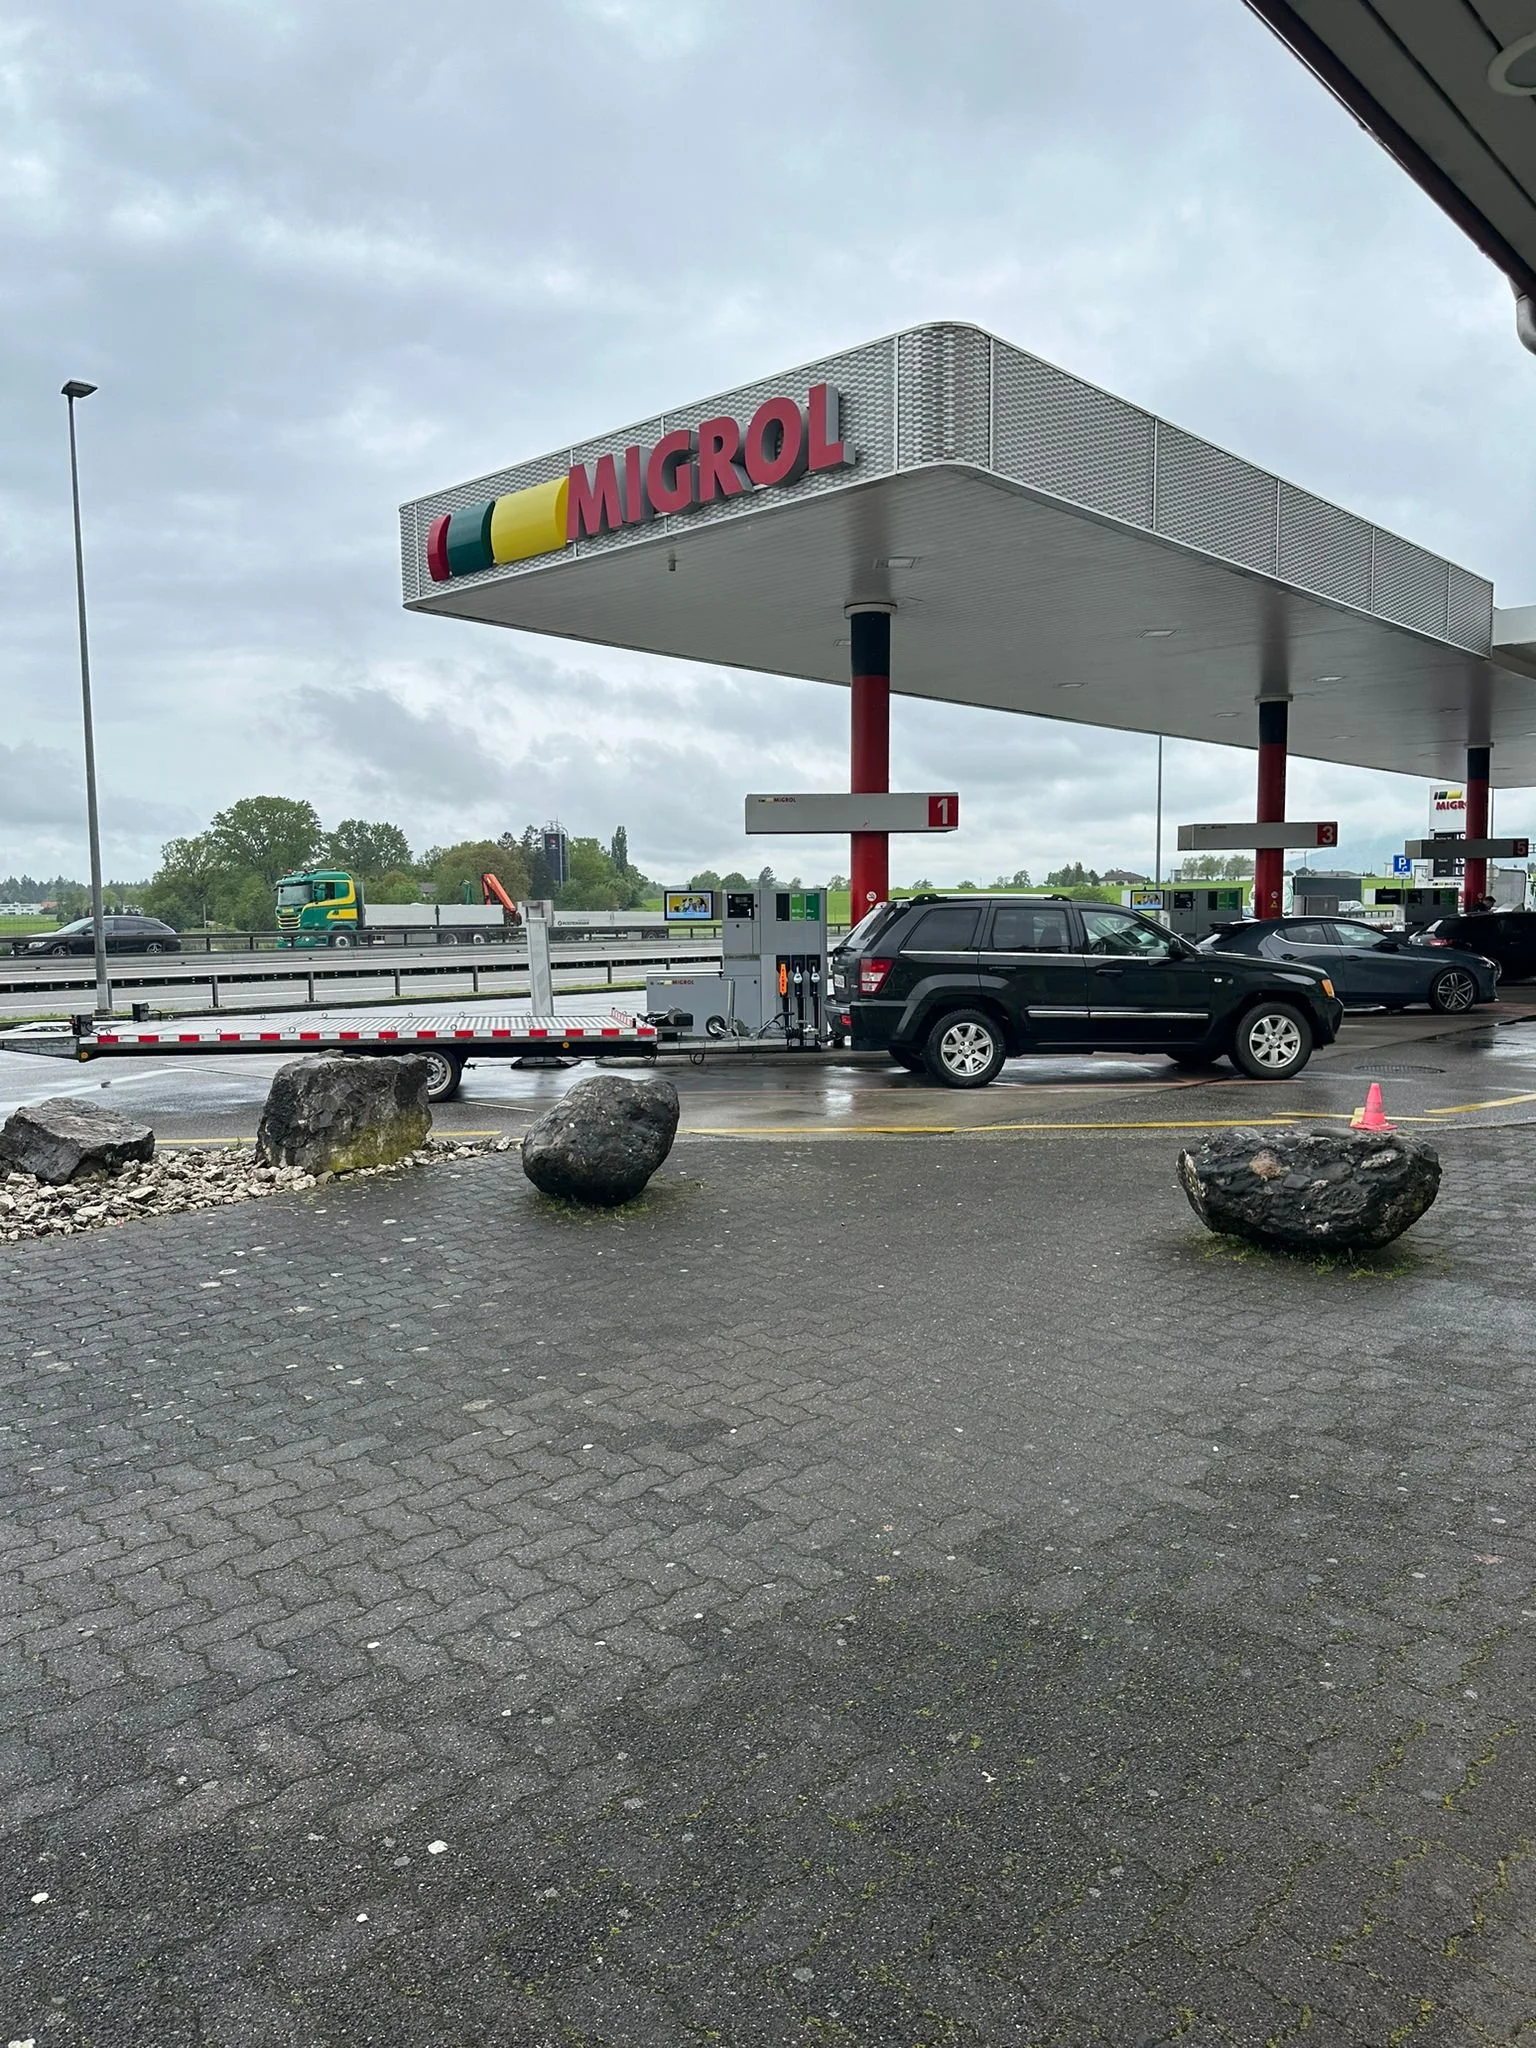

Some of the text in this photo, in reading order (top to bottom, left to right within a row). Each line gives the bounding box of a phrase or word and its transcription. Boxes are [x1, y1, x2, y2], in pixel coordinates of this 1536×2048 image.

[566, 382, 856, 540] MIGROL
[937, 798, 948, 825] 1
[1435, 801, 1466, 811] MIGR
[1321, 825, 1334, 843] 3
[1516, 840, 1527, 855] 5
[1398, 857, 1407, 869] P
[746, 908, 752, 917] 1
